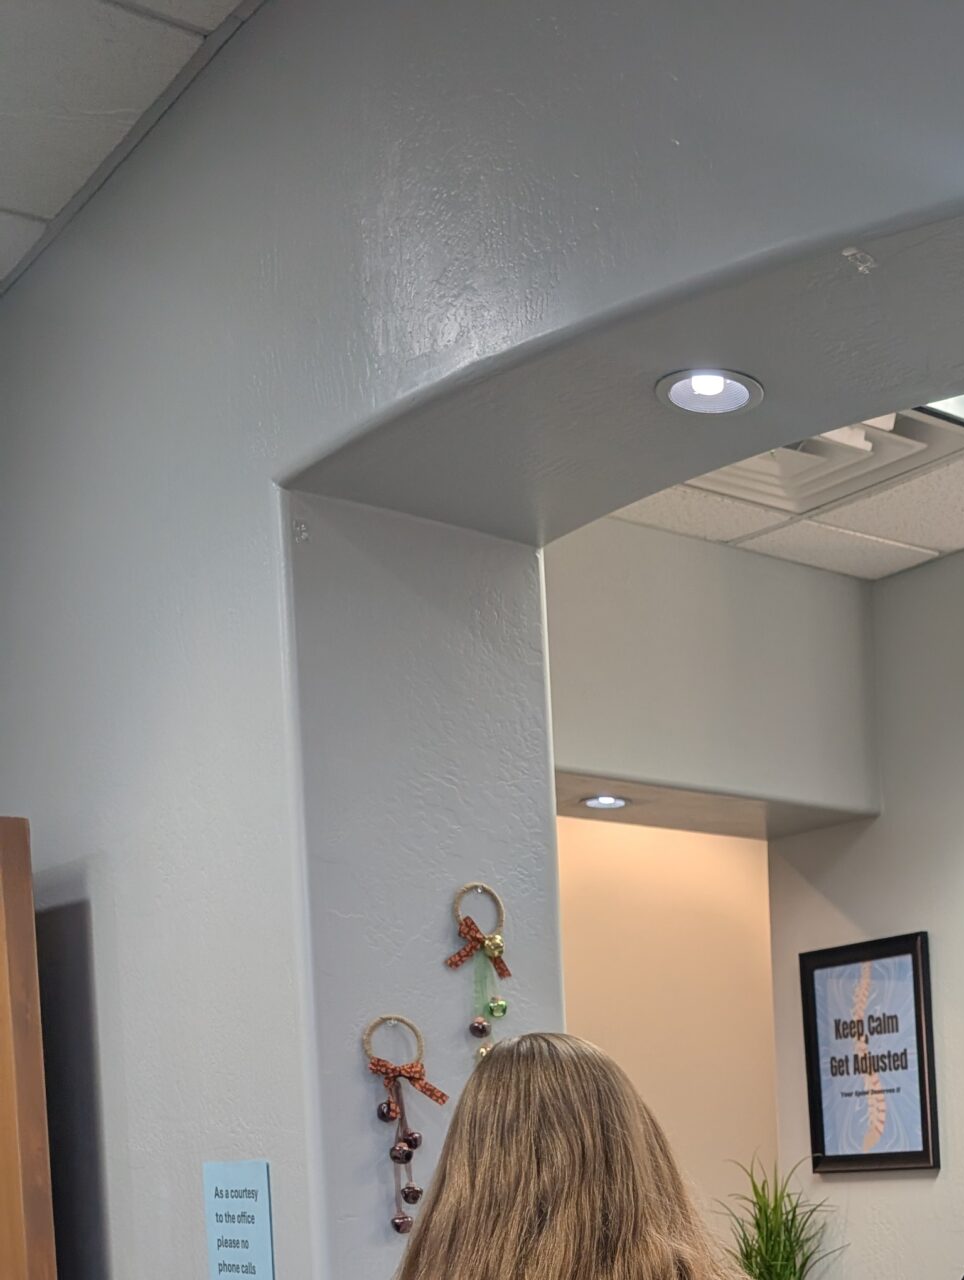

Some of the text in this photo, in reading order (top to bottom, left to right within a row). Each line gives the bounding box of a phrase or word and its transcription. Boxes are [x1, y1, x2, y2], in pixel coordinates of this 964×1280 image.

[868, 1013, 899, 1036] Calm
[830, 1048, 908, 1076] Get Adjusted
[215, 1186, 258, 1201] As a courtesy
[216, 1211, 255, 1224] to the office
[217, 1235, 249, 1250] please no
[218, 1260, 256, 1275] phone calls
